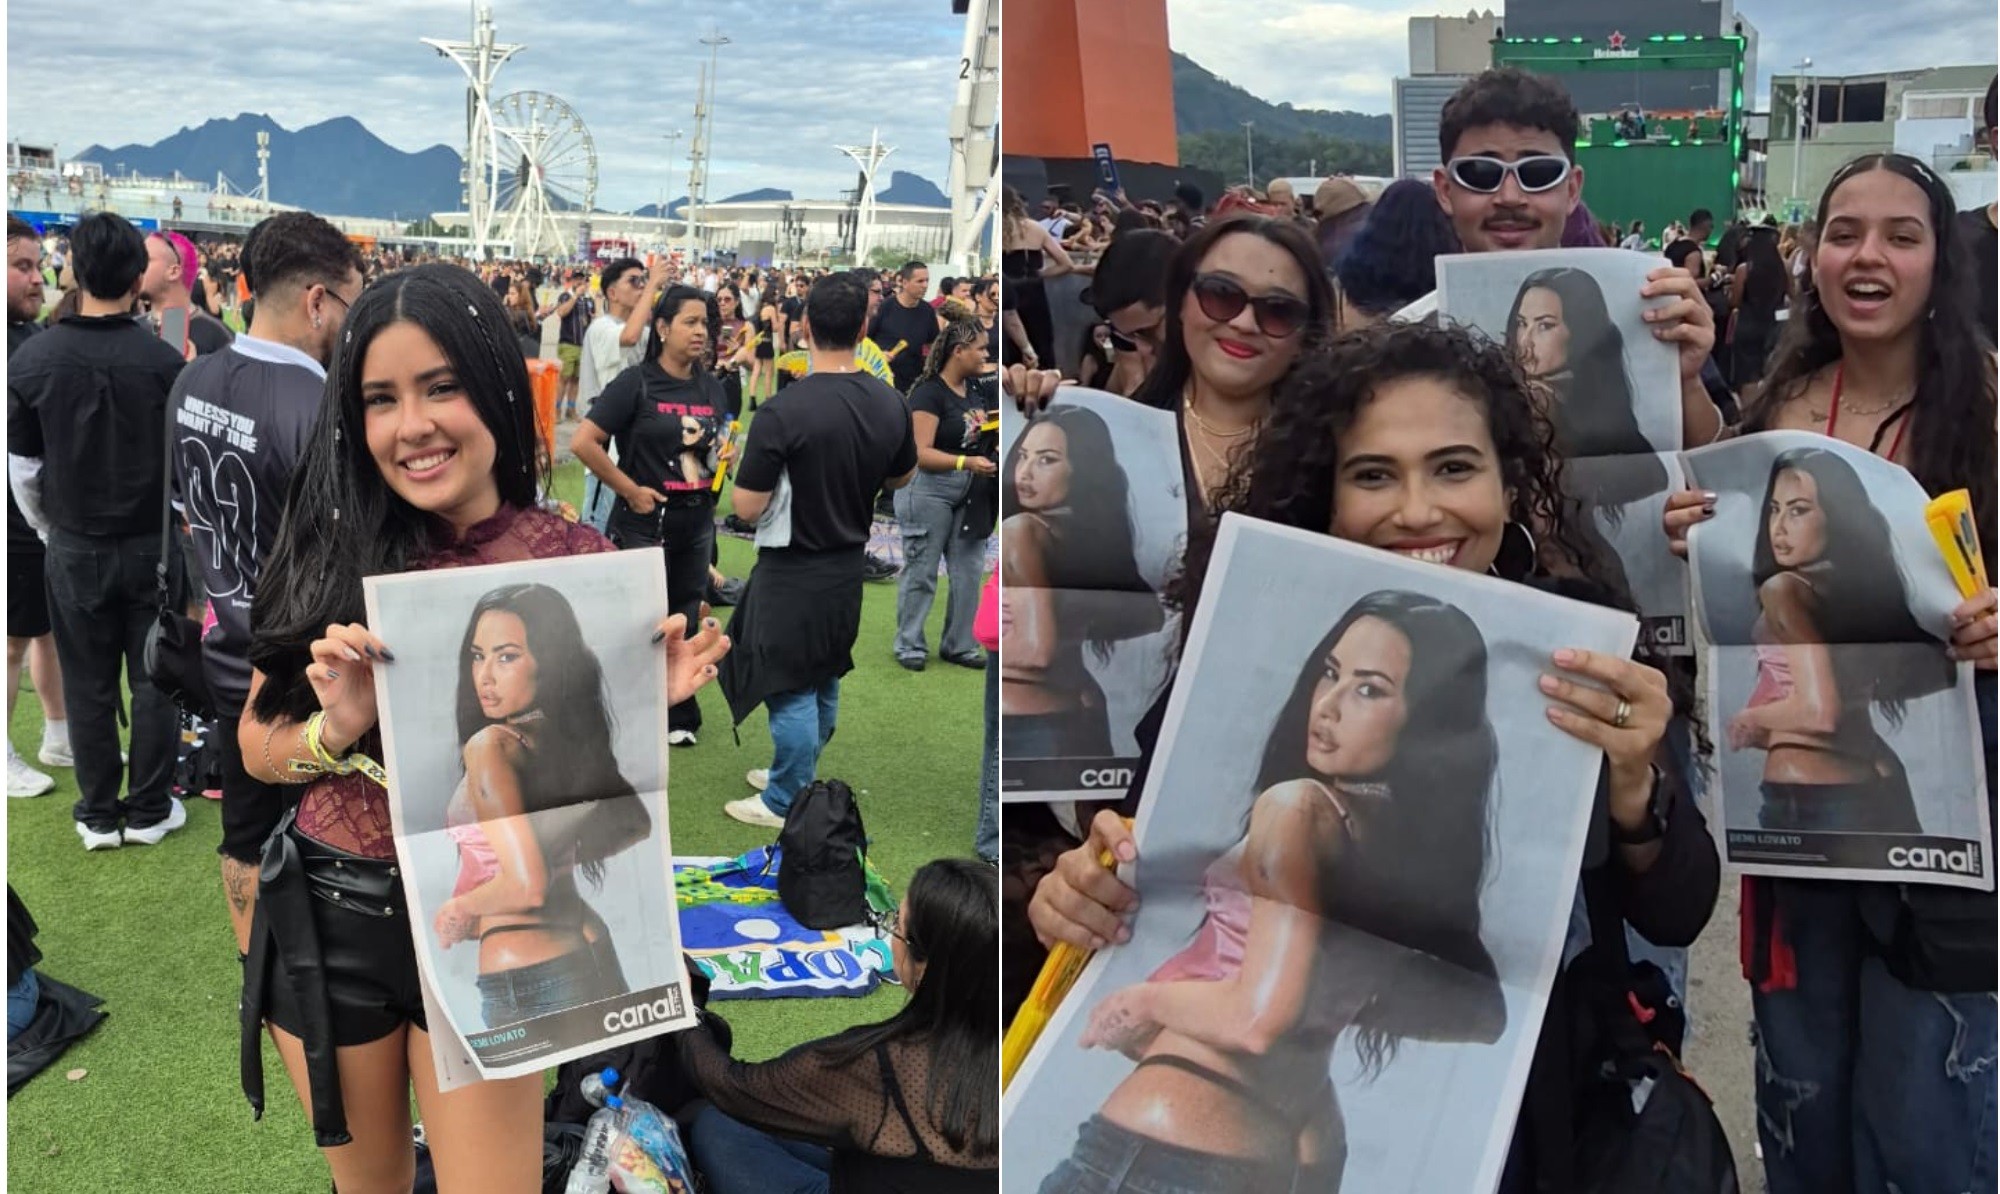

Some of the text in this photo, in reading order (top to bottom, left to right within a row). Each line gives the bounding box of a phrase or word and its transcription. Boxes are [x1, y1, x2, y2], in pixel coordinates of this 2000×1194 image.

[959, 57, 971, 79] 2
[177, 408, 212, 434] WANT
[226, 427, 240, 447] TO
[240, 435, 258, 453] BE
[184, 395, 255, 435] UNLESS YOU
[1080, 768, 1135, 787] can
[1757, 834, 1802, 845] LOVATO
[1886, 842, 1975, 874] canal
[694, 939, 894, 984] COPA
[603, 986, 676, 1033] canal
[489, 1027, 527, 1045] LOVATO
